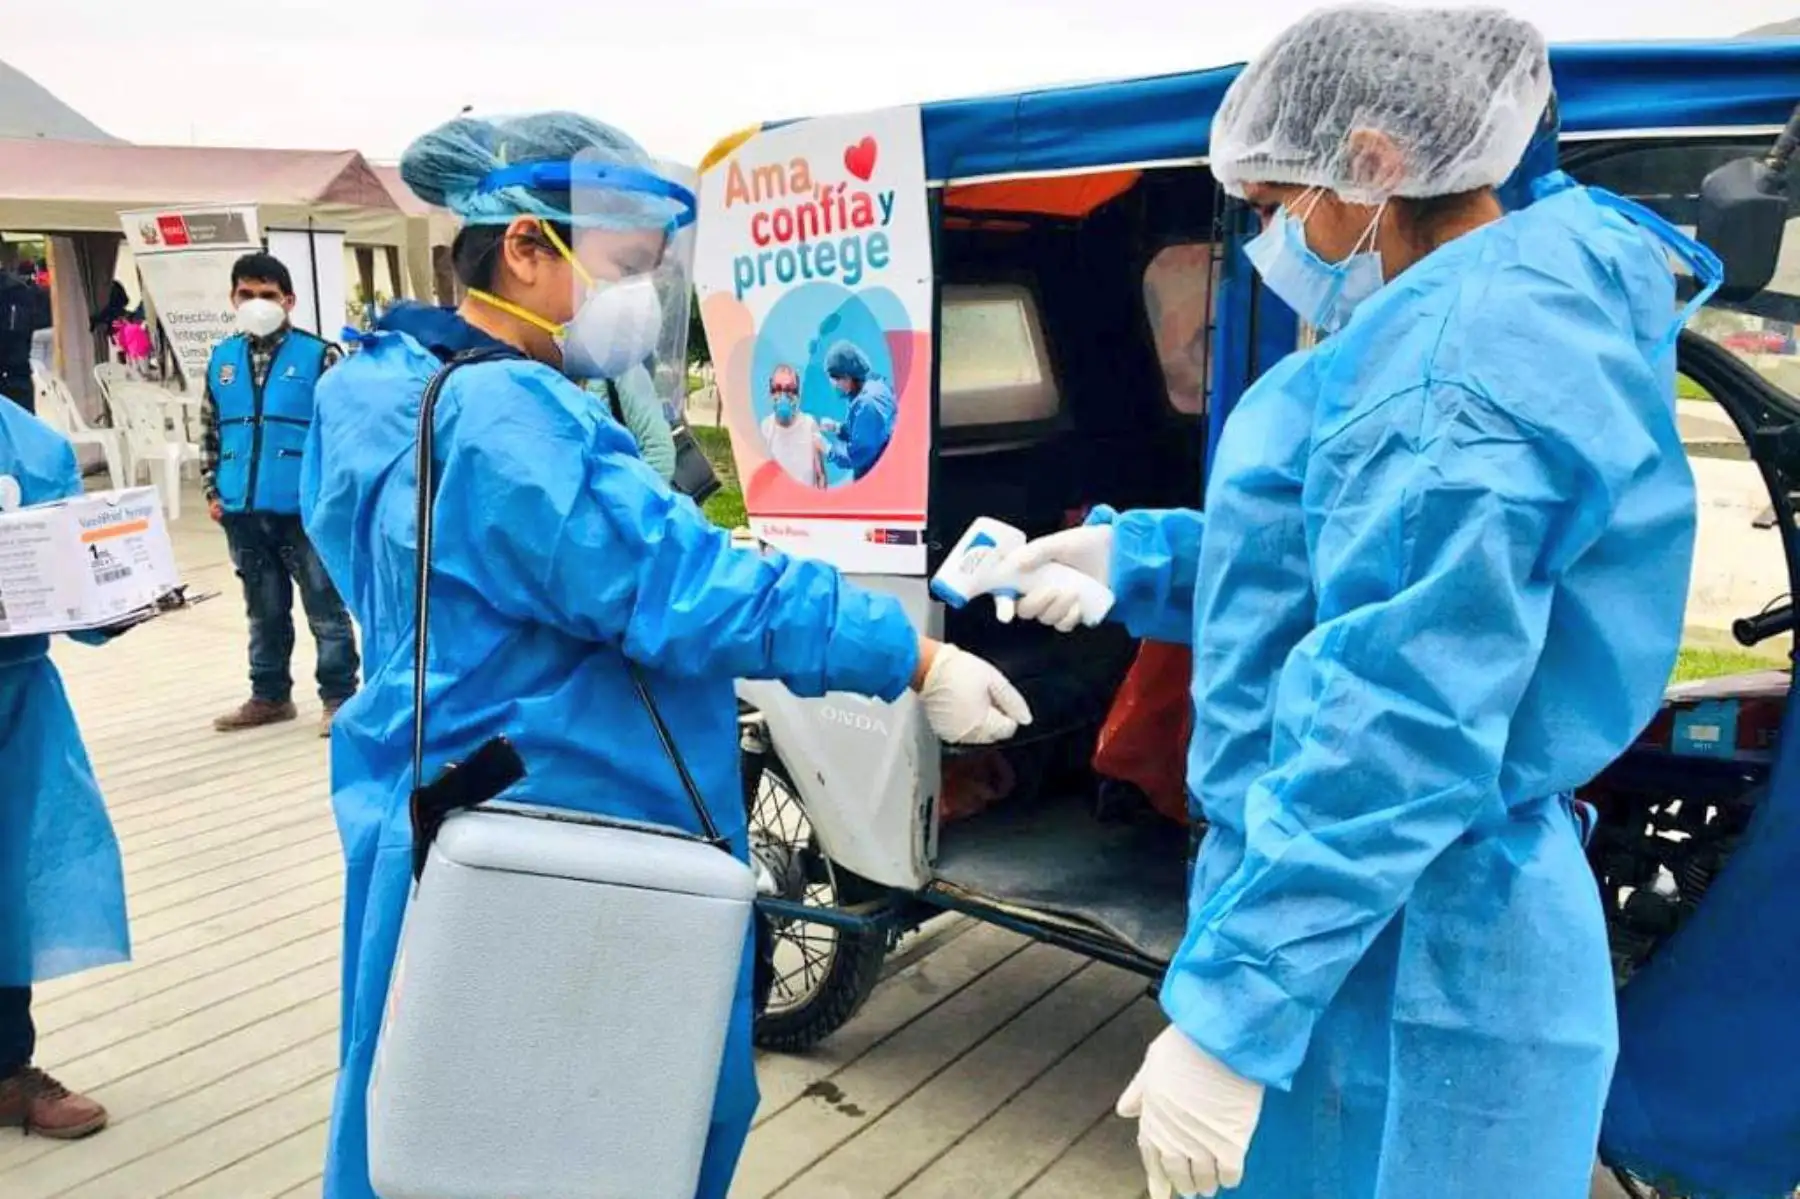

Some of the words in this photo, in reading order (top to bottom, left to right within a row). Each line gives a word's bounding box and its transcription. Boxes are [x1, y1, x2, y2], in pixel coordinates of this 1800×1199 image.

[725, 157, 820, 208] Ama,
[752, 181, 874, 247] confía
[878, 189, 895, 226] y
[734, 231, 890, 301] protege
